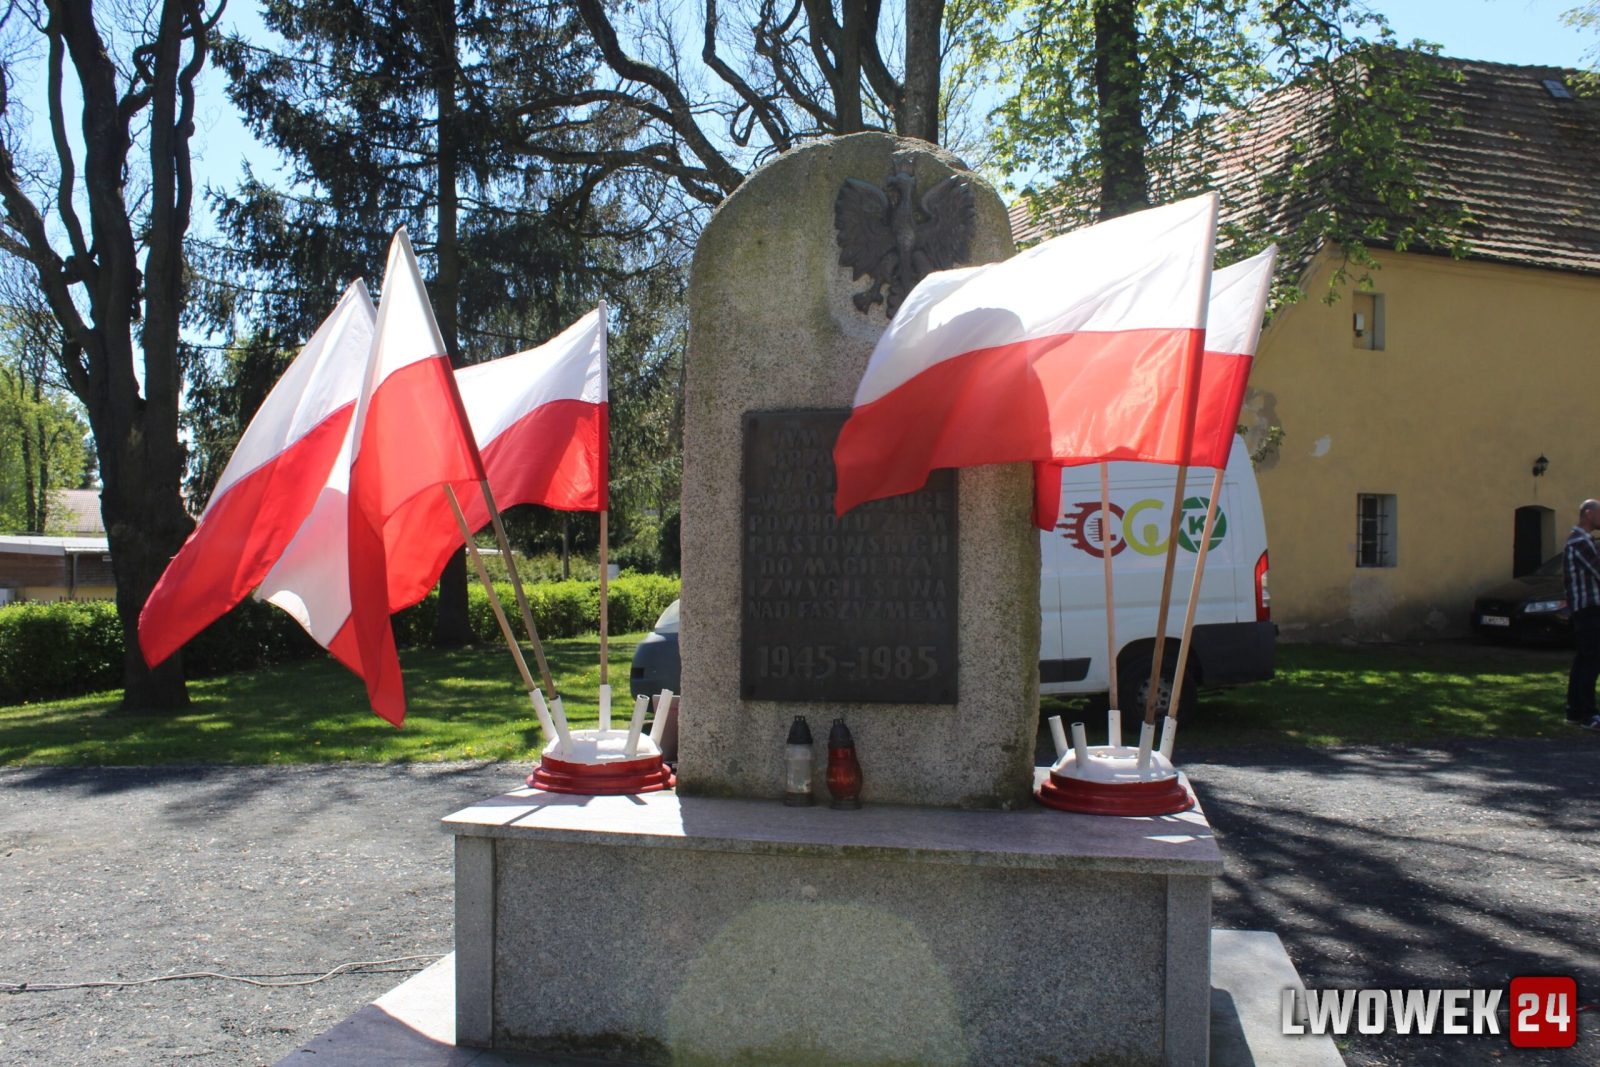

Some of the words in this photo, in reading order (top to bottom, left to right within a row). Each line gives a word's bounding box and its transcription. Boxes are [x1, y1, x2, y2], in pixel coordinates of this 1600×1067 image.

[749, 535, 948, 553] PIASTOWSKICH
[760, 557, 793, 575] DO
[748, 601, 791, 619] NAD
[798, 601, 947, 620] FASZYZMEM
[757, 645, 939, 680] 1945-1985
